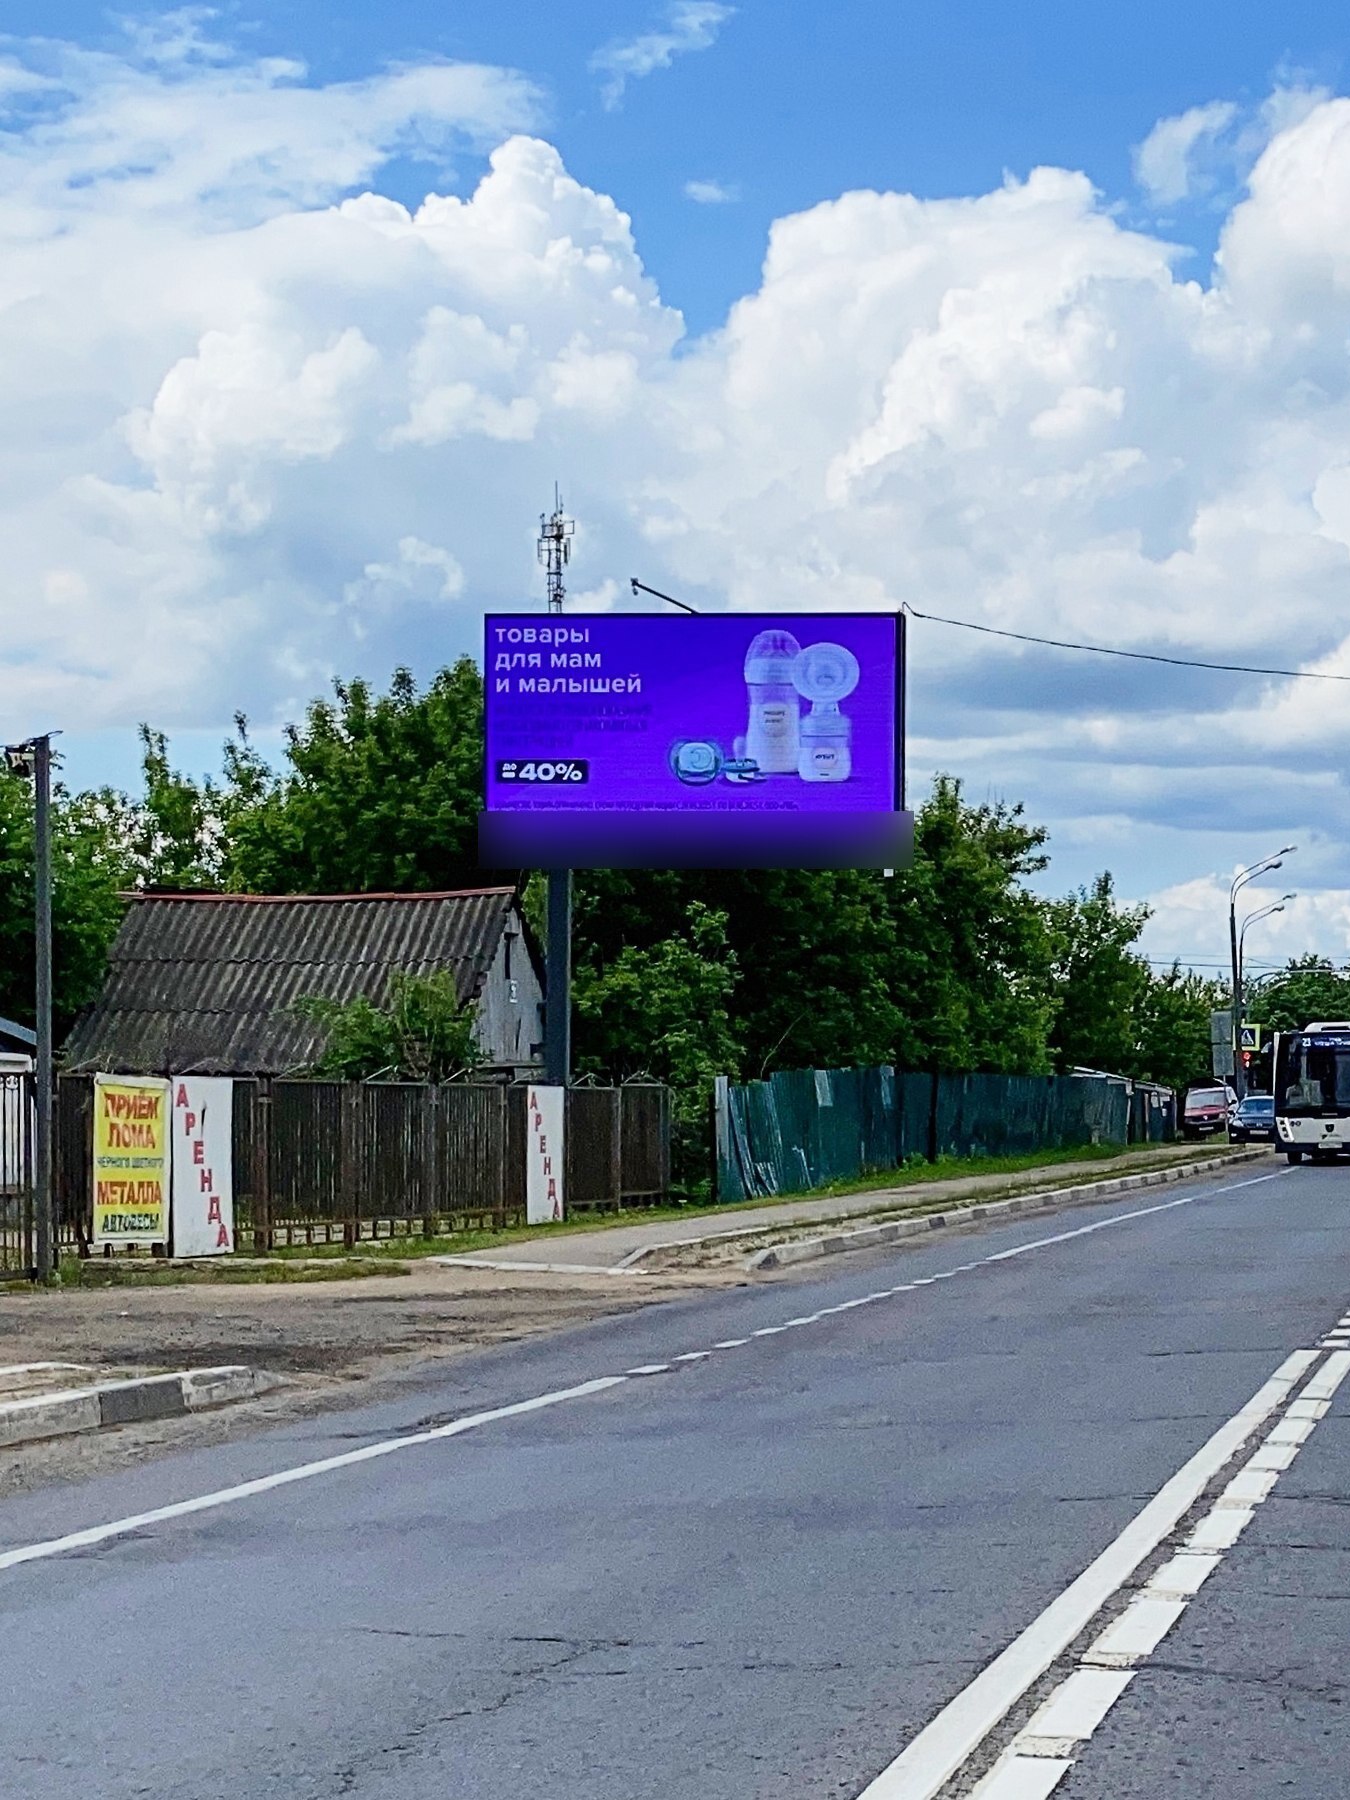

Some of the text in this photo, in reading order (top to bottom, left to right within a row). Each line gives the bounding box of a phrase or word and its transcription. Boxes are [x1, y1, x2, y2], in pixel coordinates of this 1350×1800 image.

[495, 628, 589, 648] товары
[495, 653, 602, 671] для мам
[496, 673, 642, 693] и малышей
[518, 763, 583, 781] 40%
[104, 1089, 161, 1120] ПРИЁМ
[107, 1122, 156, 1149] ЛОМА
[175, 1083, 230, 1248] АРЕНДА
[529, 1091, 560, 1218] АРЕНДА
[97, 1180, 162, 1206] МЕТАЛЛА
